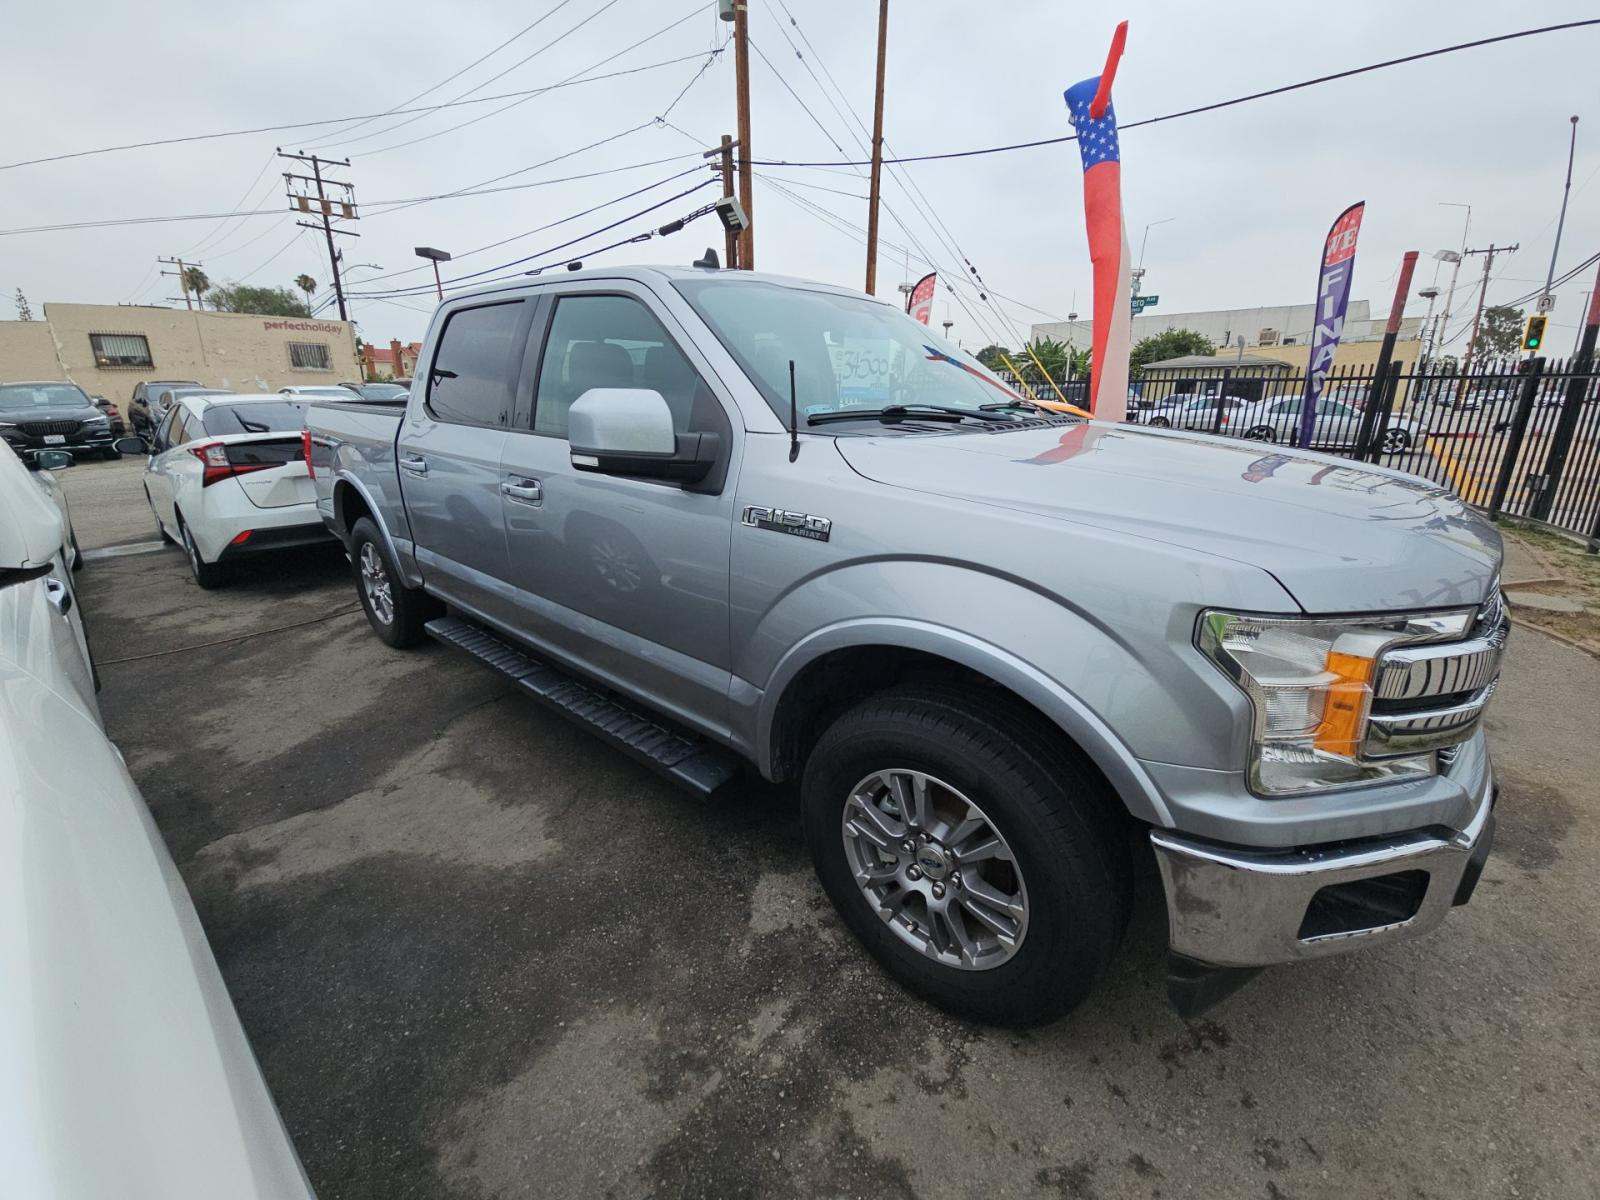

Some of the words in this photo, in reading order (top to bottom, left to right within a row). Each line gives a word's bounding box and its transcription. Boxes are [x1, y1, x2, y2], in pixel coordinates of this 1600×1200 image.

[1326, 226, 1358, 254] WE
[264, 320, 343, 335] perfectholiday
[787, 526, 822, 538] LARIAT
